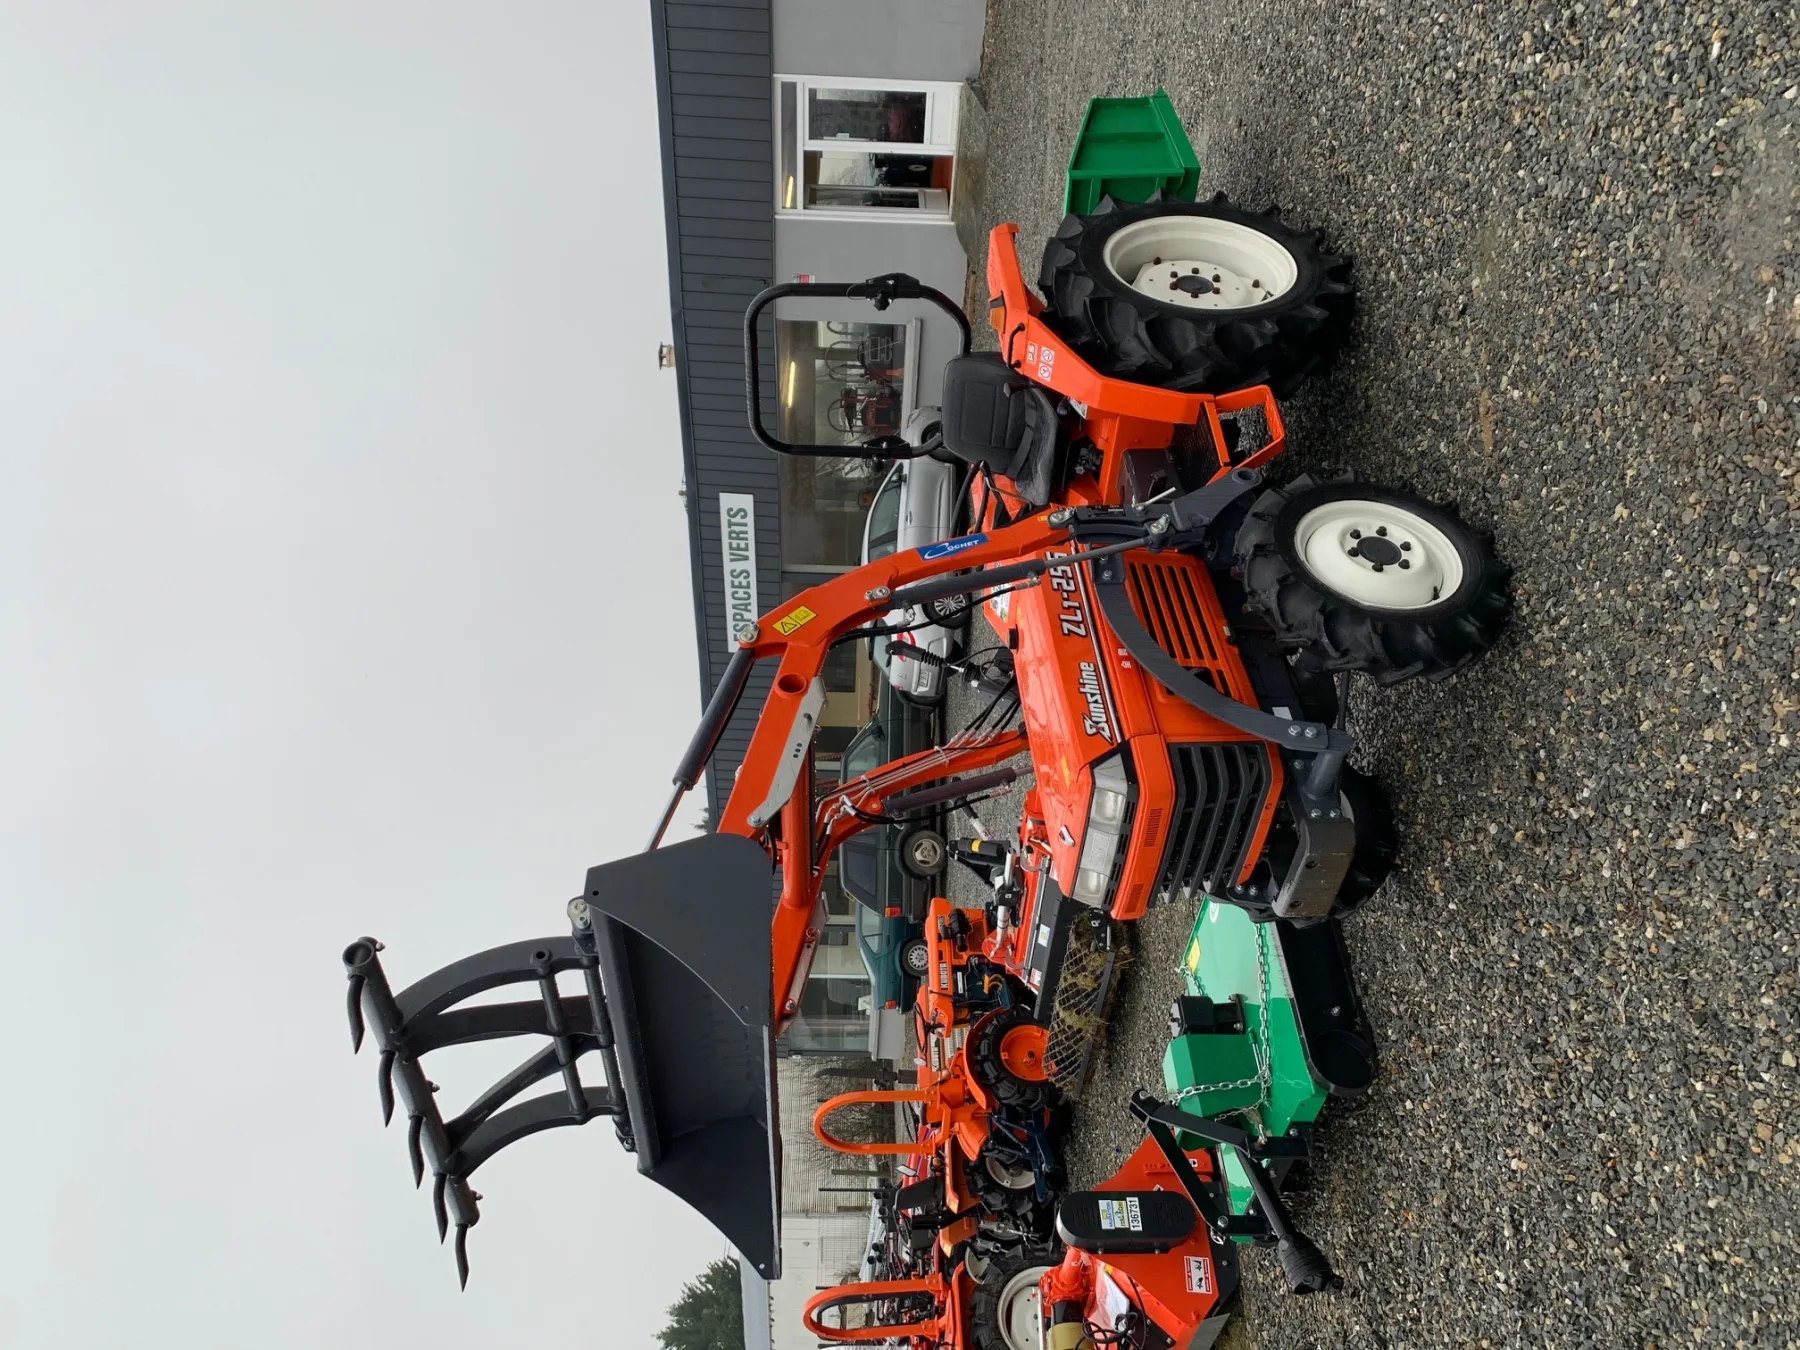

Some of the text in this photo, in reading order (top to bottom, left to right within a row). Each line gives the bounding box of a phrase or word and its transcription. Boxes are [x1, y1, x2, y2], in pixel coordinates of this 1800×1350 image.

[726, 507, 752, 642] SPACES VERTS
[1078, 661, 1113, 744] Sunshine
[939, 962, 948, 989] KUBOTA
[1129, 1200, 1140, 1229] 136731
